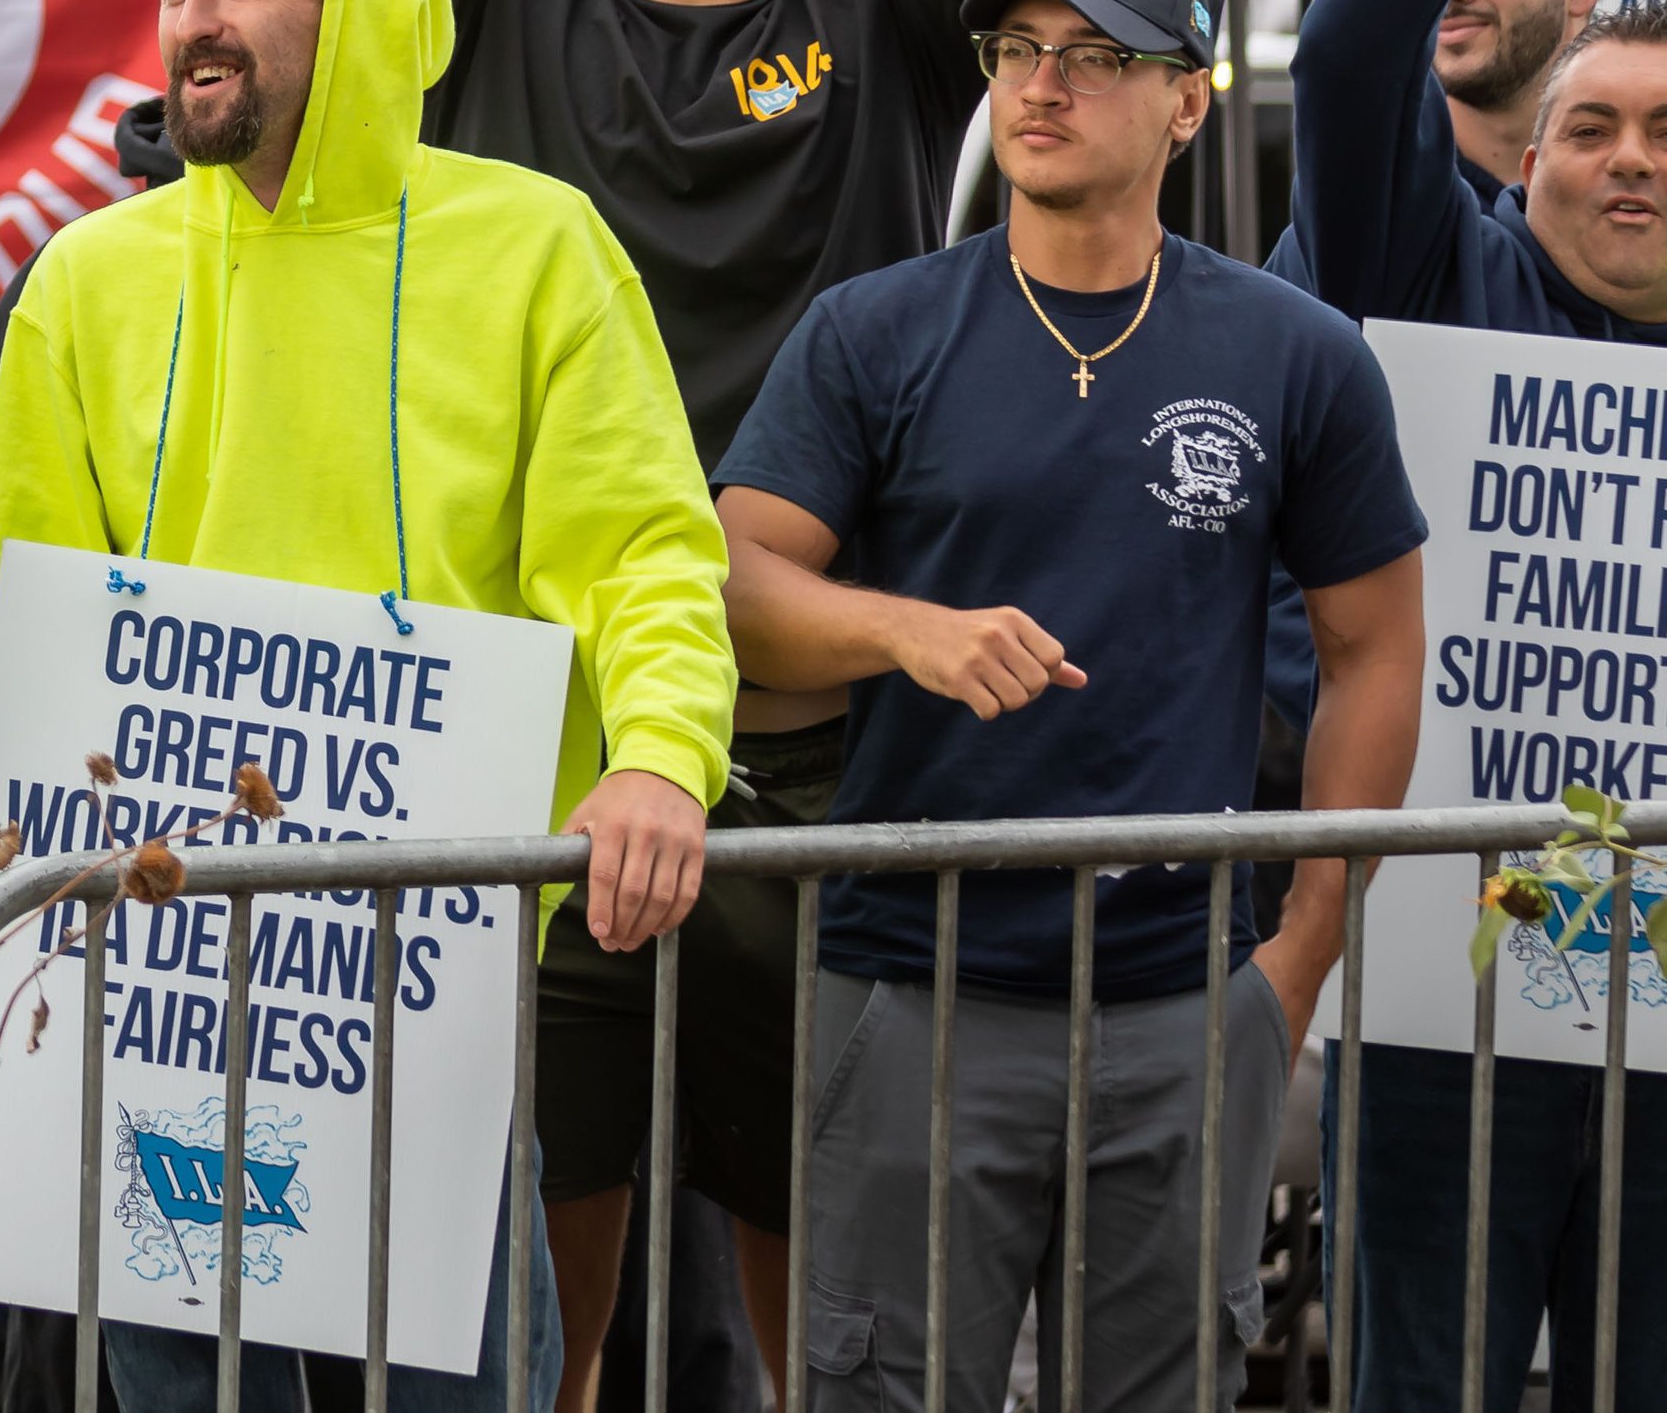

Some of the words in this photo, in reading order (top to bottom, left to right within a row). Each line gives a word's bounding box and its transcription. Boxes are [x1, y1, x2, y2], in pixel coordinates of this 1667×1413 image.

[1141, 412, 1267, 463] LONGSHOREMEN'S
[1152, 398, 1259, 436] INTERNATIONAL
[1145, 481, 1251, 517] ASSOCIATION
[1468, 461, 1640, 549] DON'T
[105, 609, 450, 733] CORPORATE
[1436, 635, 1667, 726] SUPPOR
[114, 704, 307, 802] GREED
[325, 734, 409, 822] VS.
